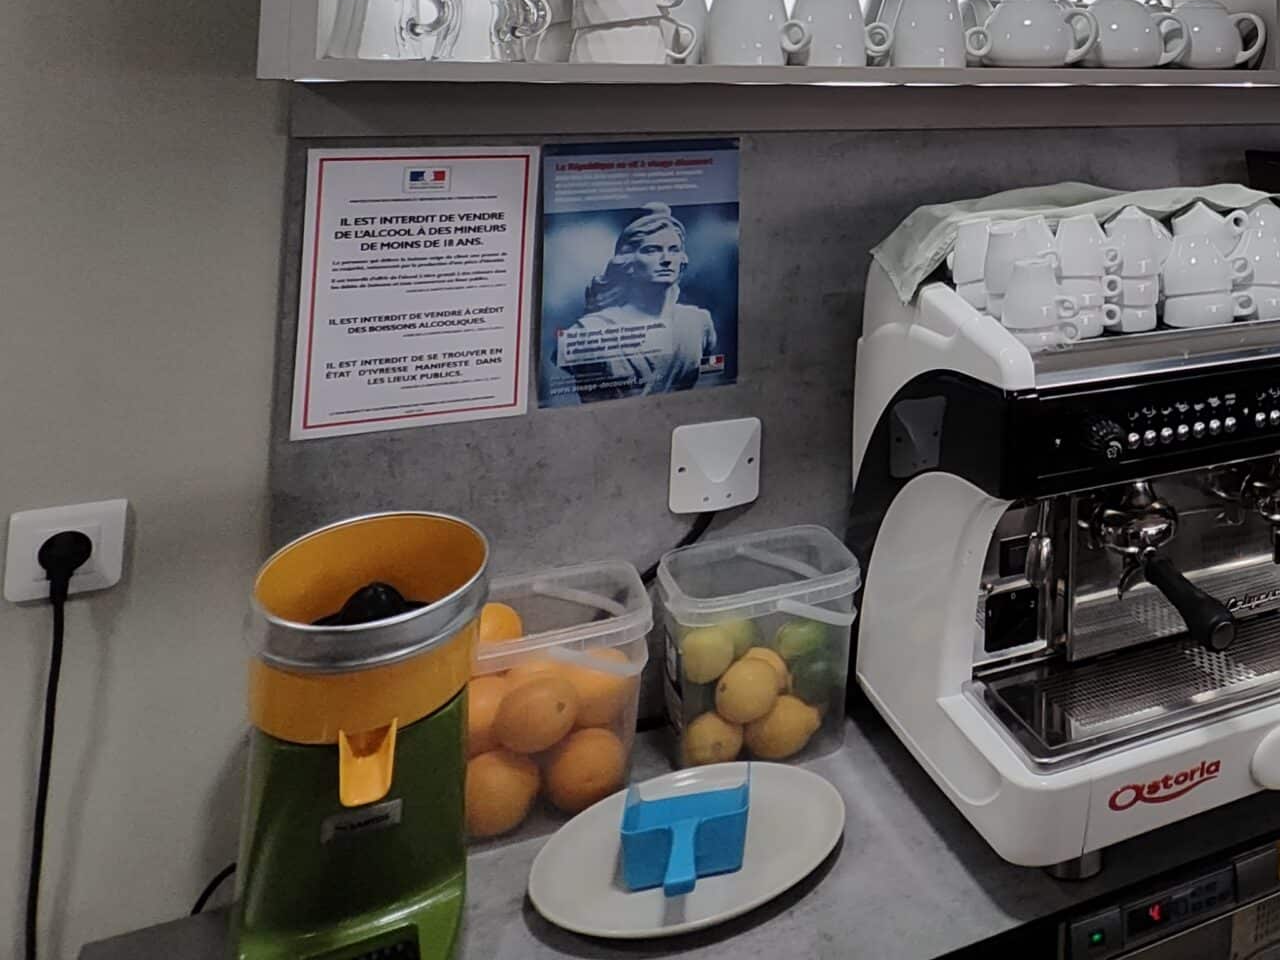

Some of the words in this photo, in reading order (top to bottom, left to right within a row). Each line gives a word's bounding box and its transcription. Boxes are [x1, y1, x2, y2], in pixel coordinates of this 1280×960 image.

[340, 217, 351, 226] IL
[354, 217, 376, 226] EST
[380, 214, 436, 225] INTERDIT
[439, 213, 455, 222] DE
[457, 211, 505, 221] VENDRE
[334, 230, 351, 239] DE
[428, 226, 451, 235] DES
[453, 224, 507, 234] MINEURS
[360, 242, 377, 251] DE
[380, 240, 421, 251] MOINS
[423, 239, 440, 248] DE
[329, 318, 338, 326] IL
[340, 317, 358, 325] EST
[360, 313, 408, 324] INTERDIT
[409, 312, 423, 320] DE
[424, 309, 463, 319] VENDRE
[347, 326, 367, 334] DES
[368, 322, 417, 333] BOISSONS
[326, 362, 336, 370] IL
[338, 360, 358, 369] EST
[360, 355, 409, 367] INTERDIT
[411, 354, 424, 362] DE
[426, 353, 439, 361] SE
[442, 349, 487, 360] TROUVER
[489, 348, 503, 356] EN
[415, 360, 469, 371] MANIFESTE
[475, 357, 502, 367] DANS
[367, 378, 385, 386] LES
[387, 375, 417, 384] LIEUX
[1108, 759, 1221, 812] Astoria
